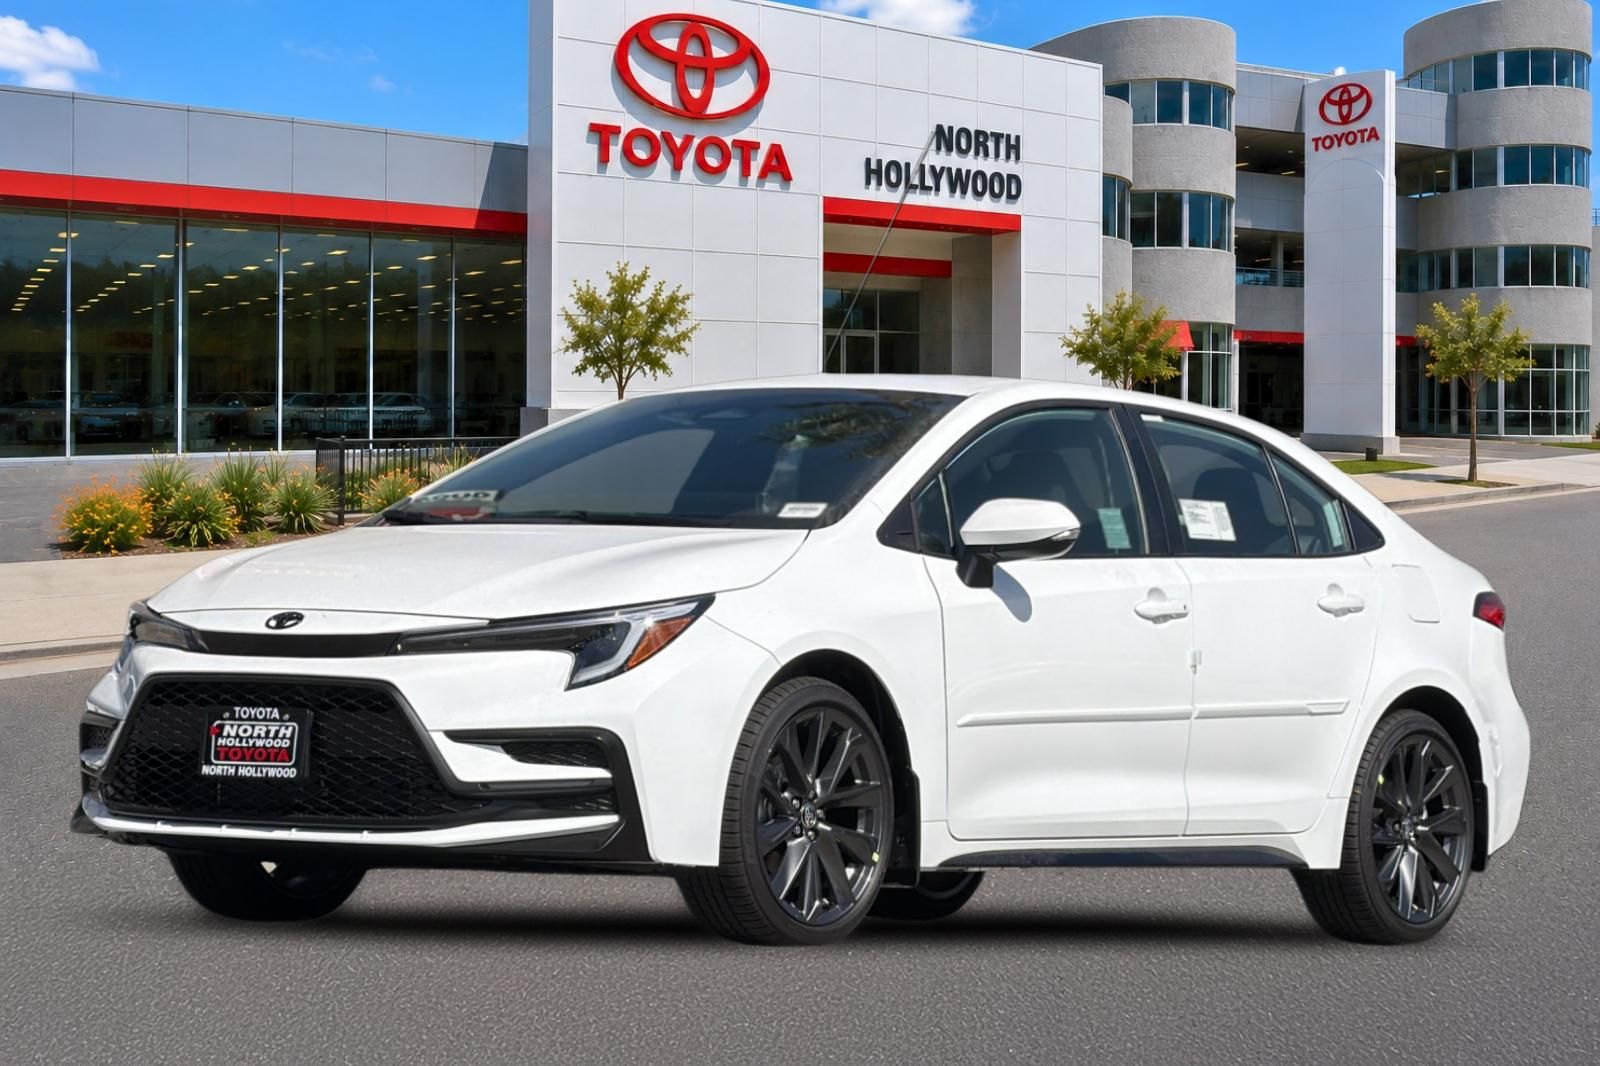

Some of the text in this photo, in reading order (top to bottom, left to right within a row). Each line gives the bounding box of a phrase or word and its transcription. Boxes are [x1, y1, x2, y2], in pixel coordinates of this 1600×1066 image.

[935, 124, 1021, 161] NORTH
[1311, 126, 1380, 152] TOYOTA
[588, 122, 793, 182] TOYOTA
[864, 157, 1022, 201] HOLLYWOOD
[233, 706, 280, 719] TOYOTA
[222, 725, 293, 738] NORTH
[217, 738, 290, 747] HOLLYWOOD
[217, 748, 289, 761] TOYOTA
[201, 765, 297, 778] NORTH HOLLYWOOD
